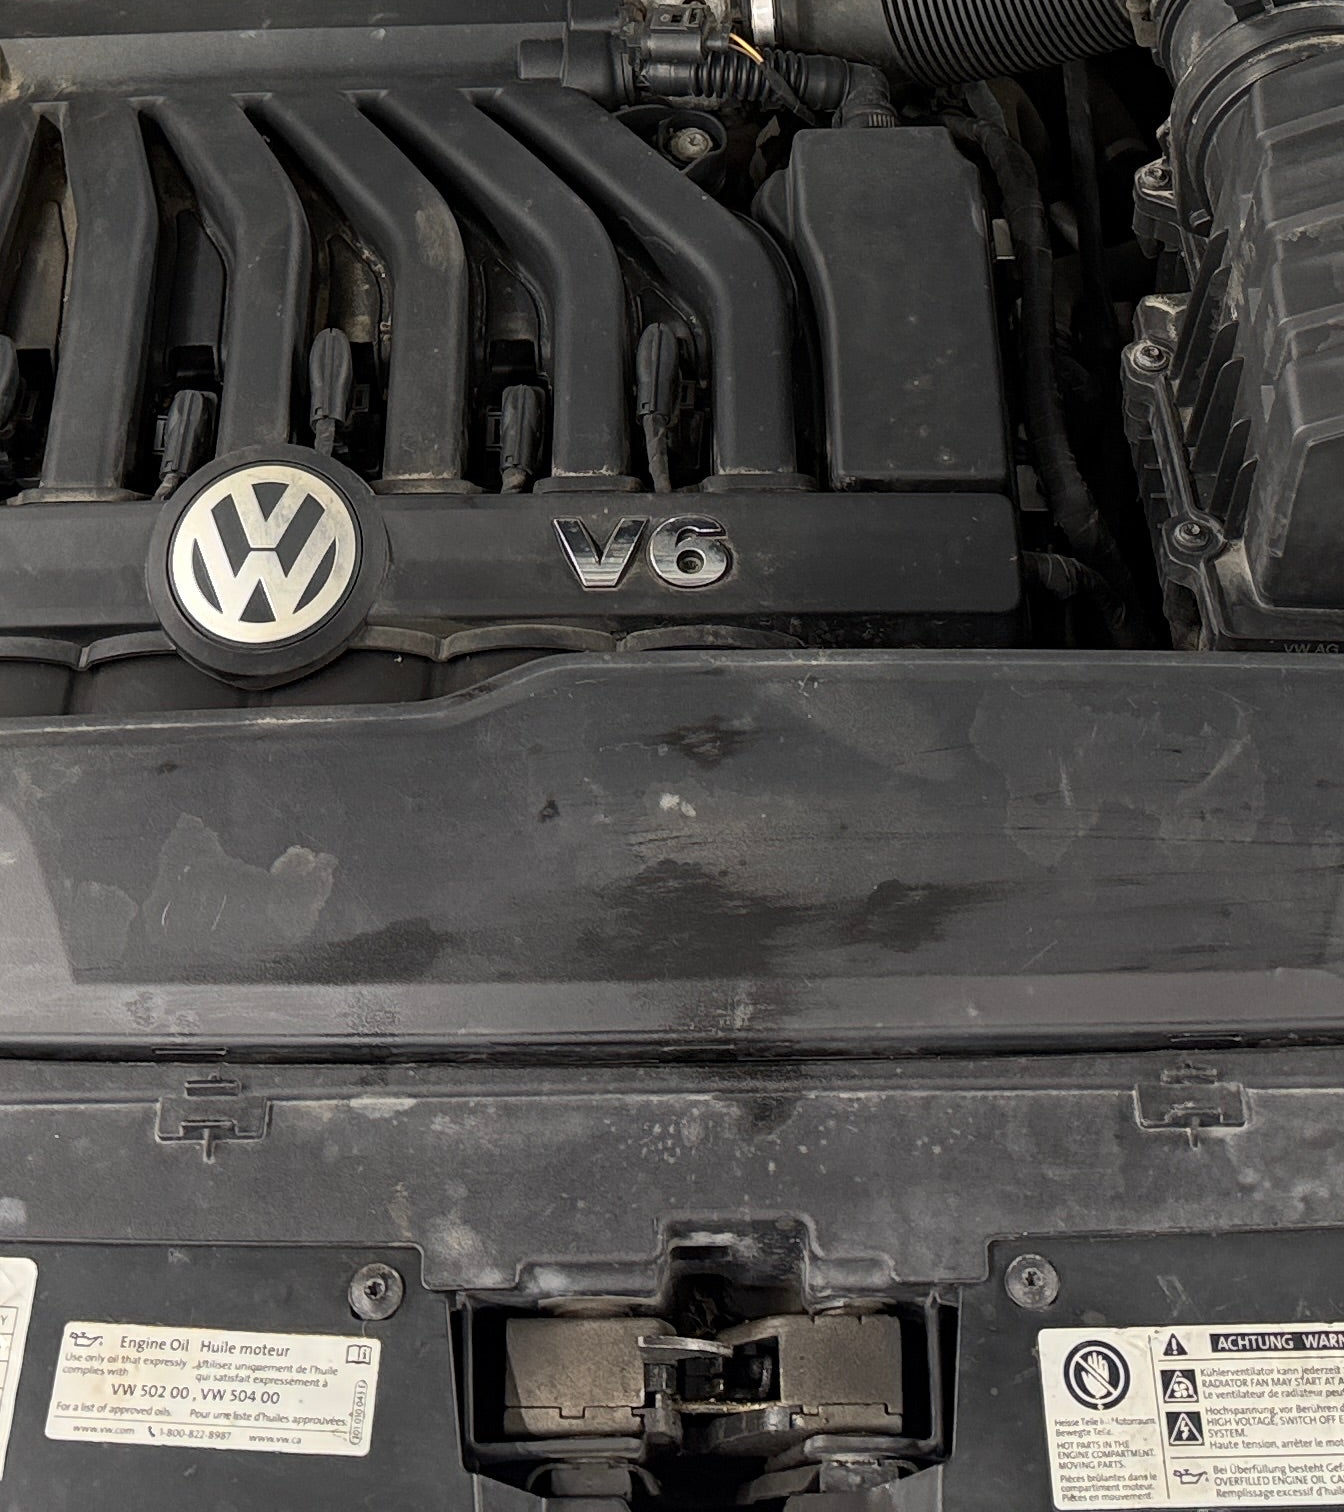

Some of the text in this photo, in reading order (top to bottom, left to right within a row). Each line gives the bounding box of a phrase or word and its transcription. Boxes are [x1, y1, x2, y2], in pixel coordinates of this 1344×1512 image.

[171, 464, 357, 644] VW
[552, 515, 734, 591] V6
[1283, 643, 1340, 654] VW AG
[120, 1336, 291, 1357] Engine Oil Huile moteur
[1217, 1334, 1295, 1351] ACHTUNG
[65, 1352, 83, 1362] Use
[85, 1353, 105, 1365] only
[121, 1354, 141, 1366] that
[143, 1356, 187, 1370] expressly
[62, 1365, 129, 1378] complies with
[234, 1361, 294, 1376] uniquement
[1276, 1364, 1341, 1379] kann jederzeit
[196, 1372, 251, 1385] qui satisfait
[1201, 1378, 1248, 1389] RADIATOR
[1250, 1378, 1269, 1388] FAN
[1271, 1377, 1295, 1388] MAY
[1296, 1376, 1323, 1387] START
[111, 1383, 281, 1405] VW 502 VW 504 00
[1215, 1389, 1265, 1399] ventilateur
[56, 1400, 71, 1412] For
[109, 1404, 152, 1418] approved
[1279, 1407, 1294, 1415] vor
[190, 1408, 290, 1424] Pour une liste d'huiles
[1207, 1417, 1232, 1427] HIGH
[1280, 1415, 1316, 1426] SWITCH
[1318, 1414, 1336, 1425] OFF
[1057, 1441, 1074, 1450] HOT
[1076, 1440, 1100, 1450] PARTS
[1210, 1439, 1239, 1450] Haute
[1058, 1450, 1089, 1460] ENGINE
[1059, 1461, 1095, 1470] MOVING
[1288, 1463, 1324, 1474] besteht
[1214, 1476, 1270, 1487] OVERFILLED
[1272, 1475, 1308, 1486] ENGINE
[1310, 1474, 1327, 1485] OIL
[1216, 1487, 1274, 1500] Remplissage
[1276, 1486, 1314, 1498] excessif
